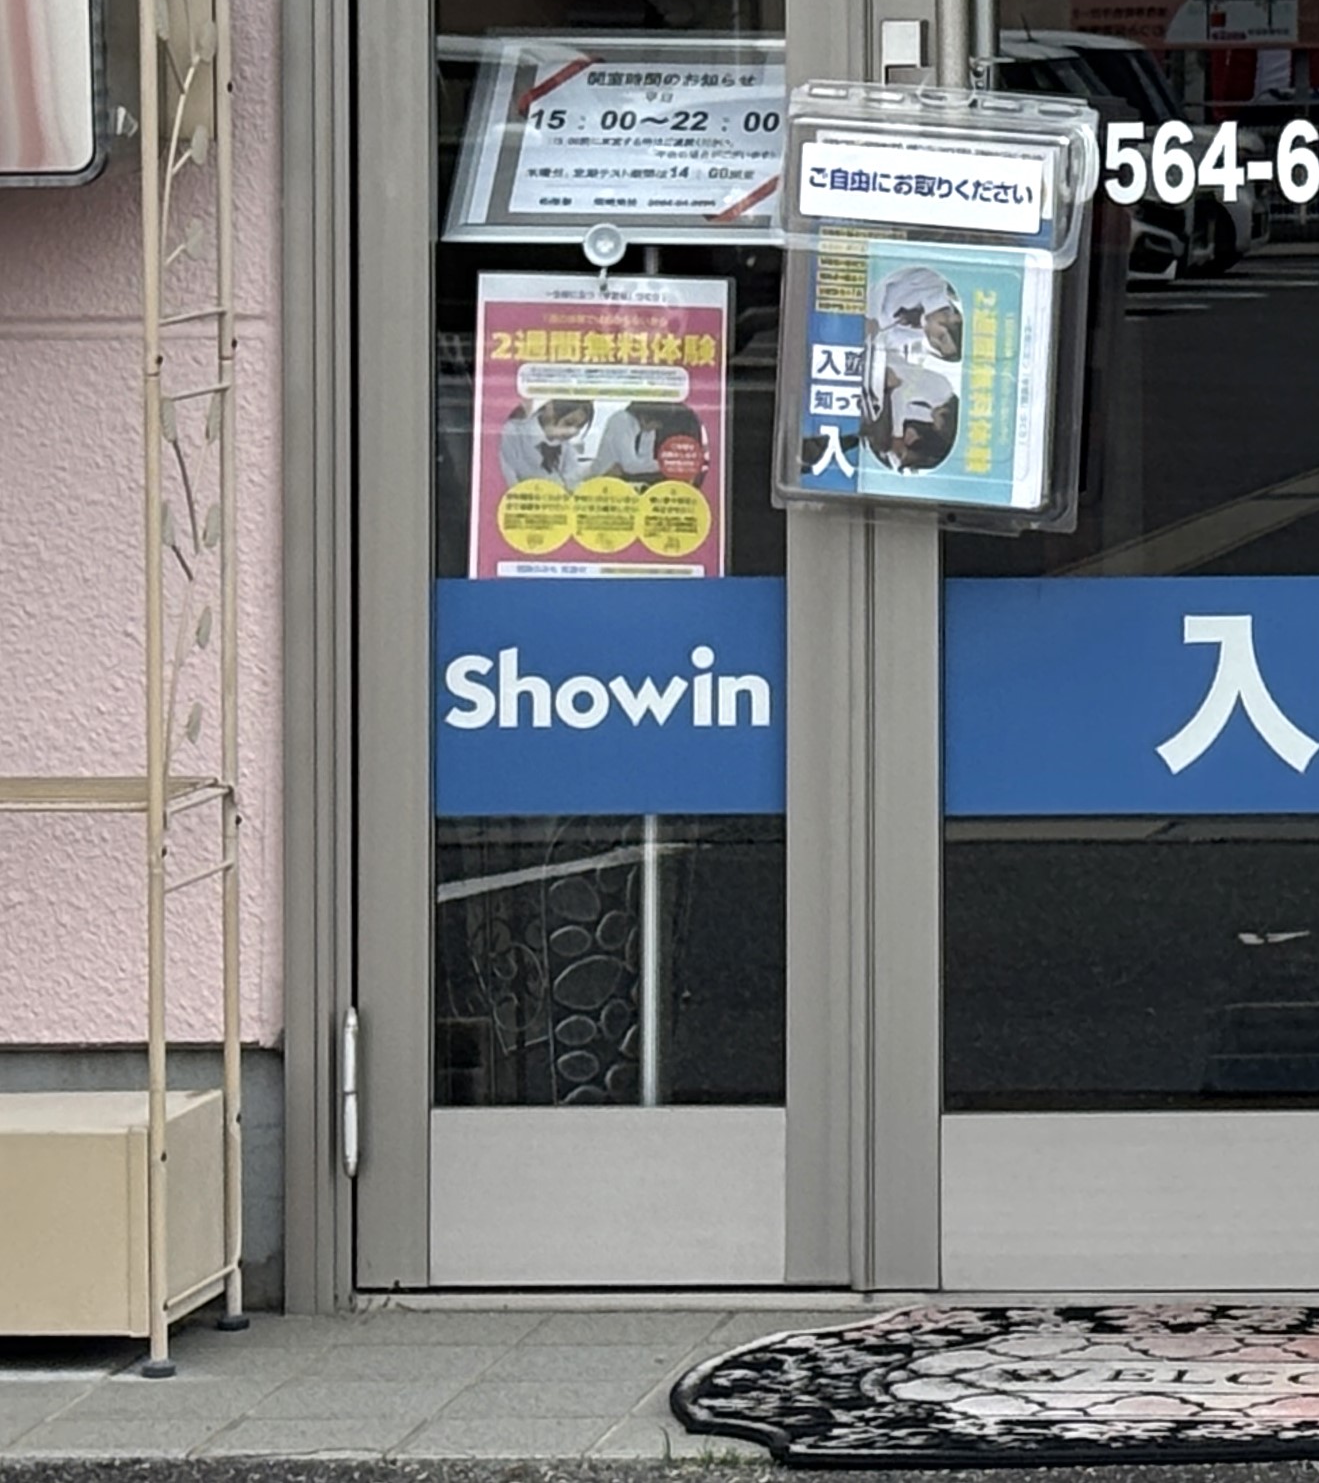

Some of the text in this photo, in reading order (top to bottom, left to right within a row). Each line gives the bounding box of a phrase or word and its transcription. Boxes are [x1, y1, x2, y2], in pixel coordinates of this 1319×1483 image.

[808, 166, 1034, 205] ご自由にお取りください
[490, 328, 716, 367] 2週間無料体験
[444, 646, 770, 728] Showin
